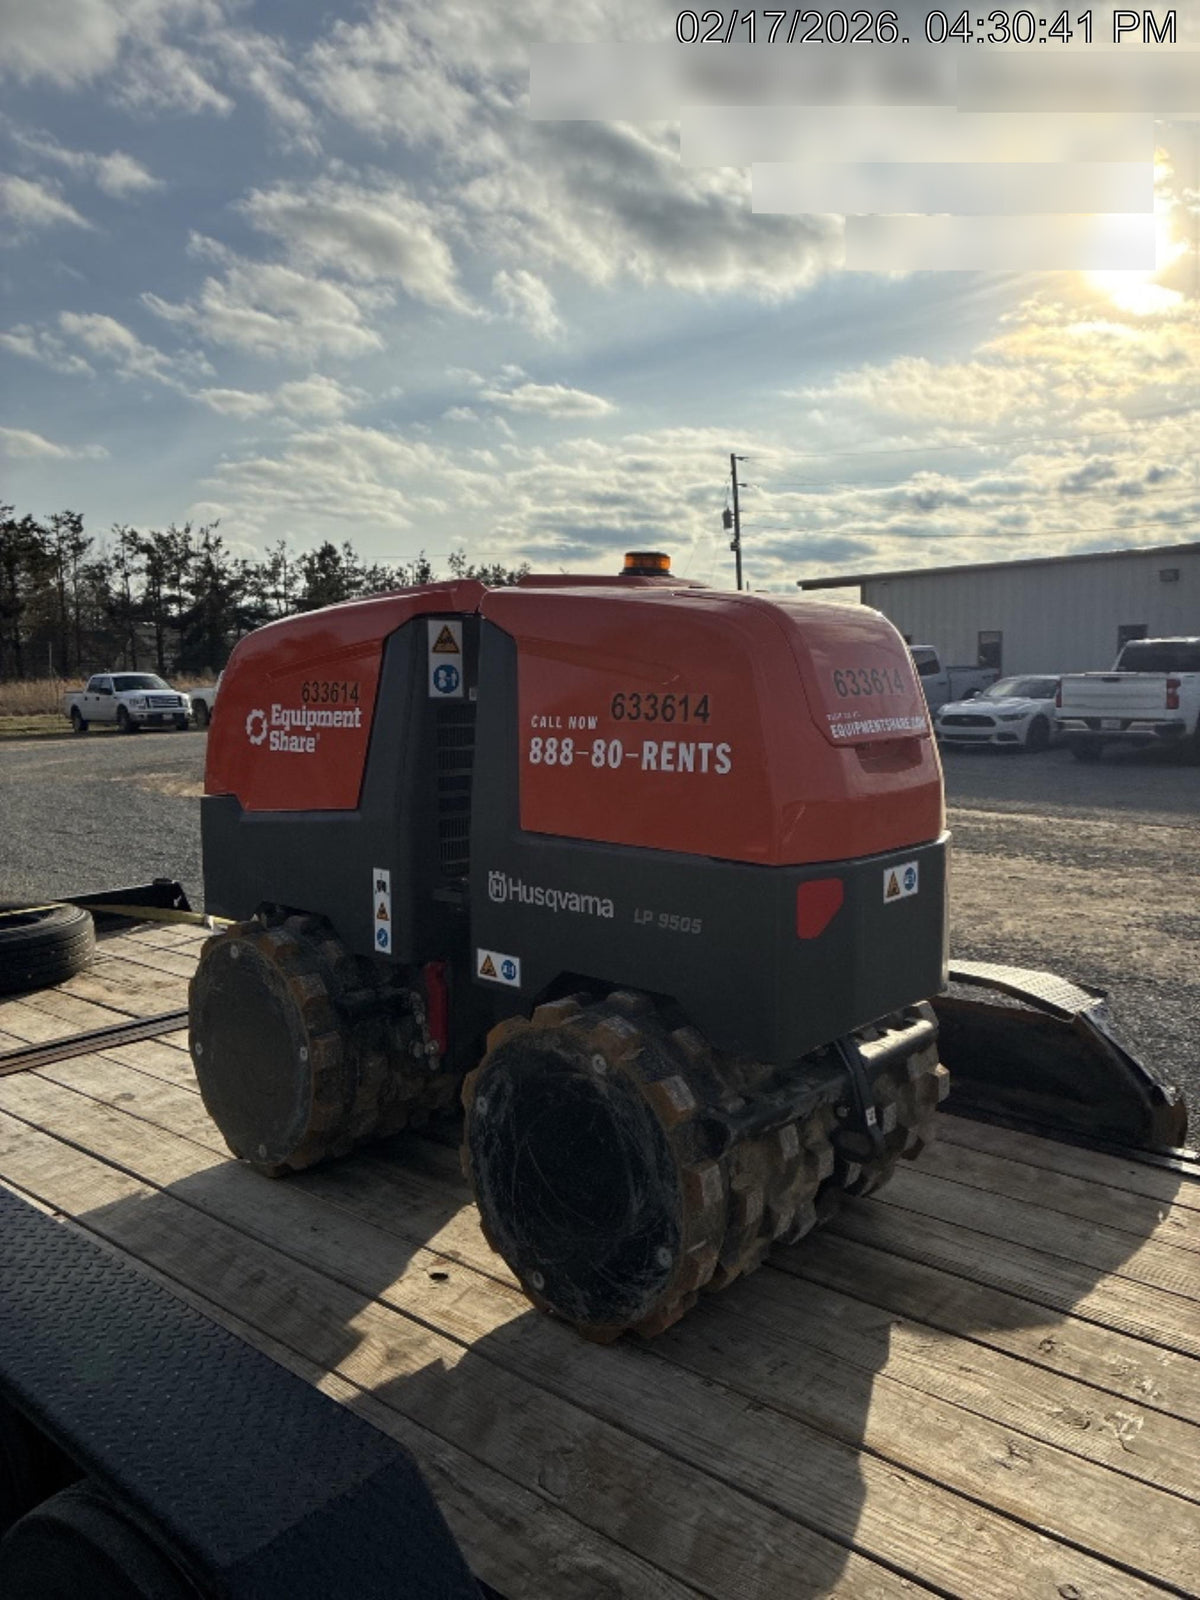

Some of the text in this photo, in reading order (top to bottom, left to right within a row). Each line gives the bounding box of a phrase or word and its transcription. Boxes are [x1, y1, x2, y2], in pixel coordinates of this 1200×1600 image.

[302, 681, 359, 703] 633614
[833, 668, 905, 698] 633614
[271, 703, 362, 731] Equipment
[531, 714, 598, 730] CALL NOW
[611, 693, 710, 724] 633614
[529, 737, 732, 775] 888-80-RENTS
[508, 877, 615, 919] Husqvarna
[632, 907, 653, 925] LP
